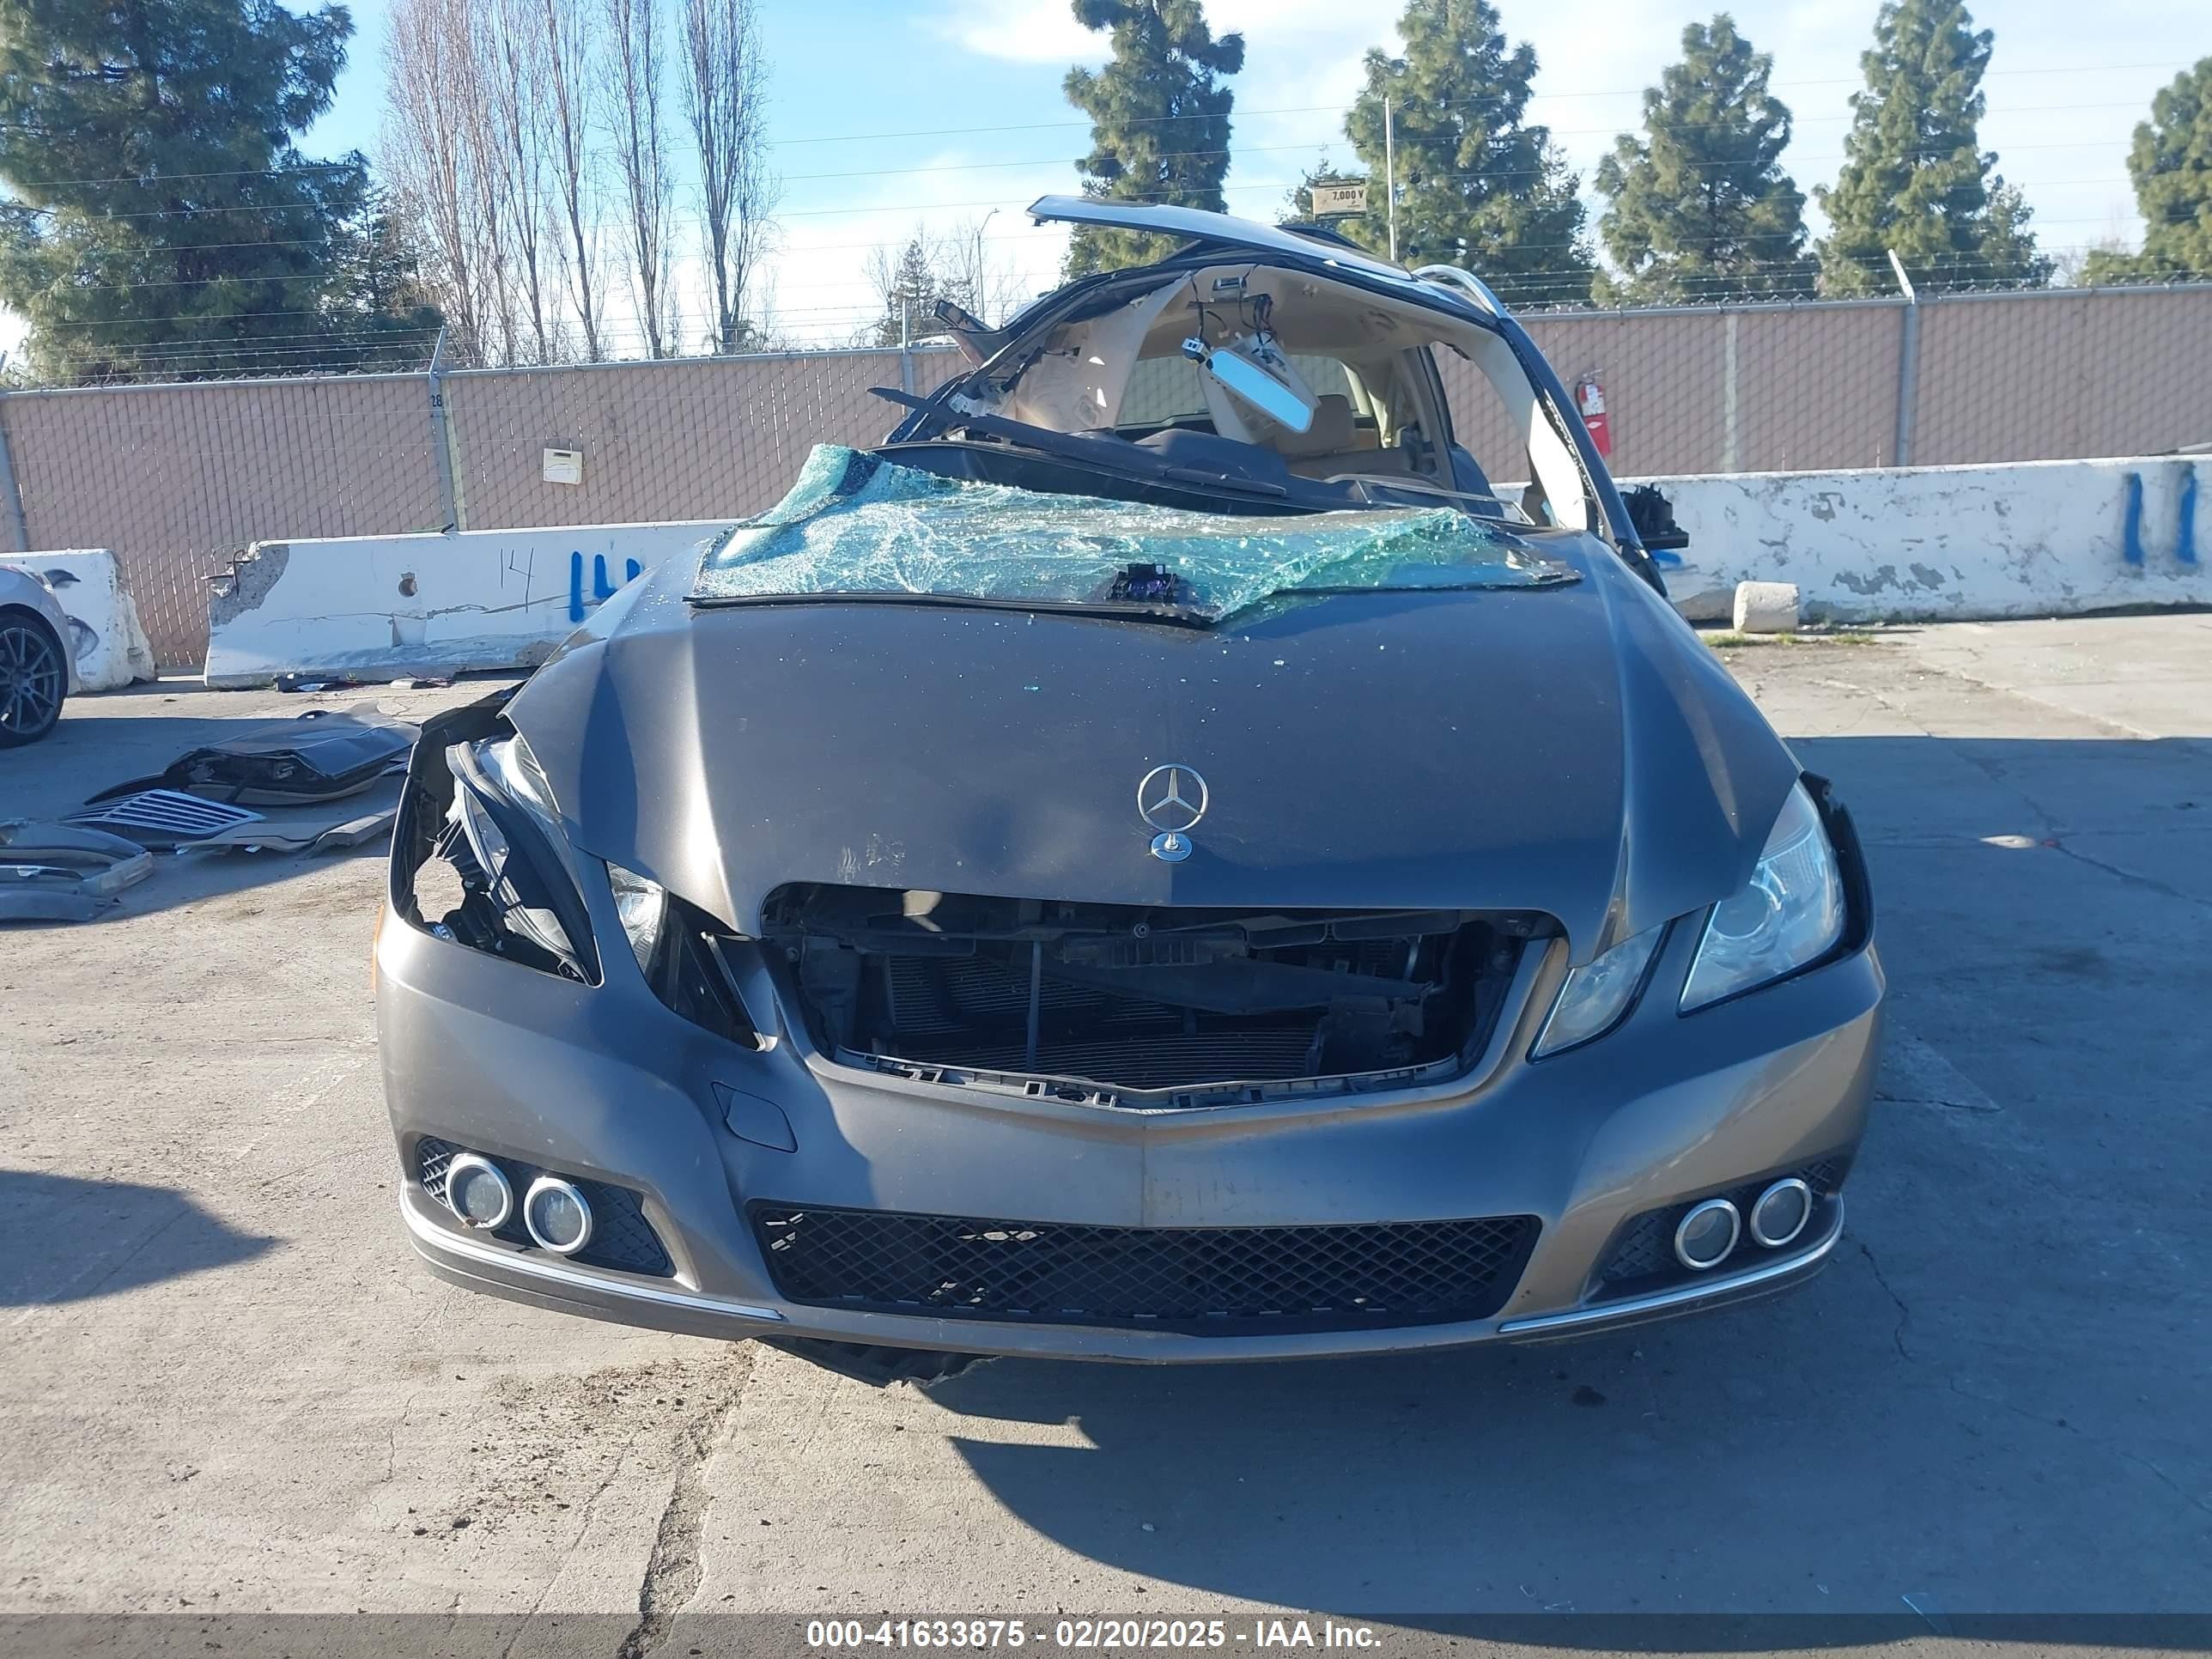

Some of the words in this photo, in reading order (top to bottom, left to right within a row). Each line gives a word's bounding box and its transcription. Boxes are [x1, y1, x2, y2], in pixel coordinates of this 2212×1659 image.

[1332, 191, 1356, 201] 7,000
[1358, 190, 1364, 198] V
[431, 394, 442, 407] 28
[501, 547, 534, 613] 14
